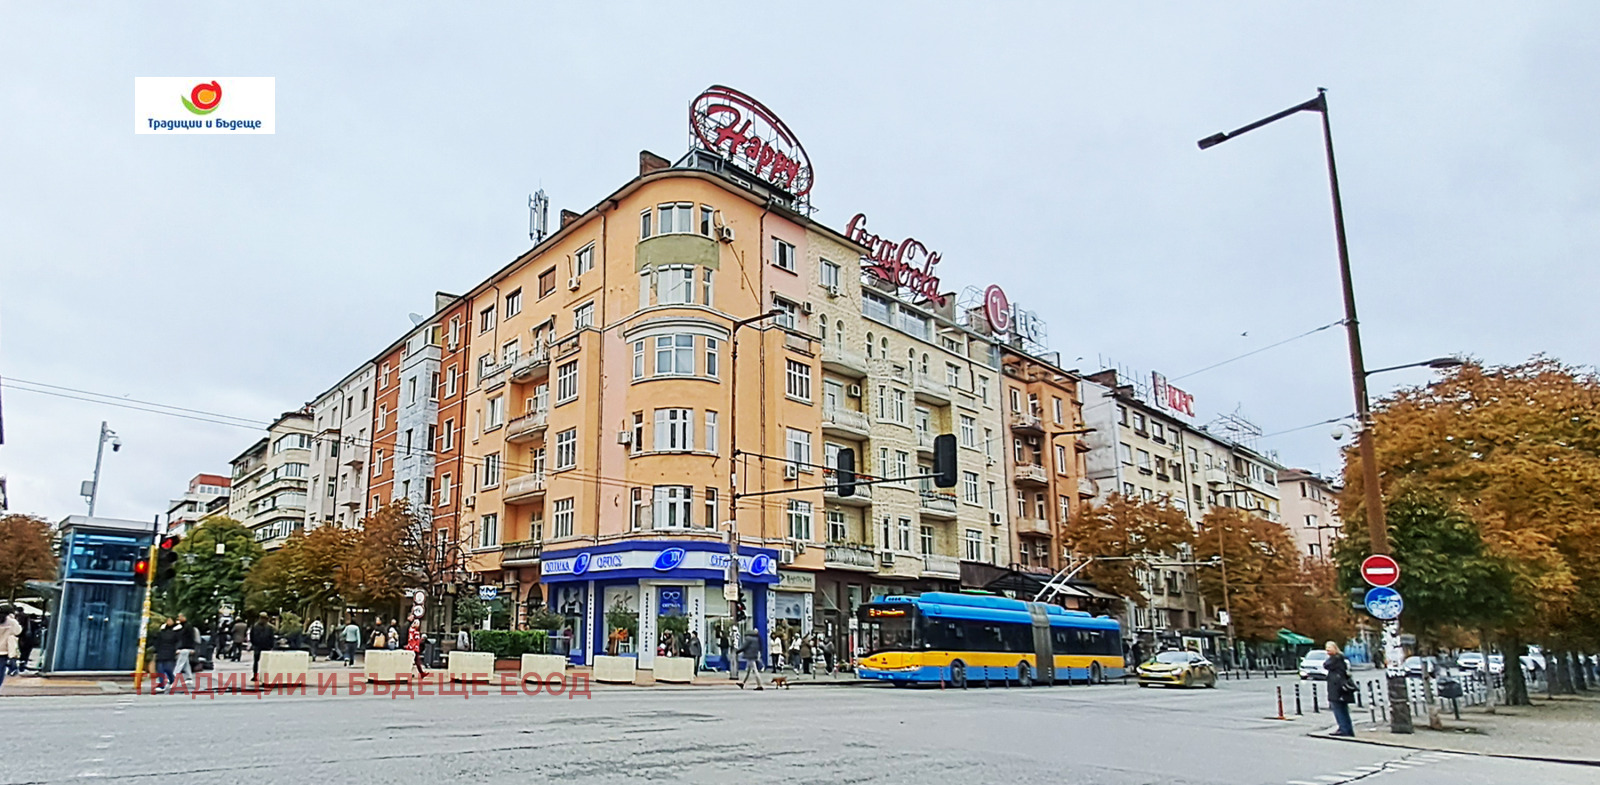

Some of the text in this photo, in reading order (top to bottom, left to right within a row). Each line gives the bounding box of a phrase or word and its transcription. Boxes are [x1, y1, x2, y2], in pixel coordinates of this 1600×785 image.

[707, 104, 801, 189] Happy
[1013, 302, 1041, 343] LG
[1167, 384, 1196, 418] KFC
